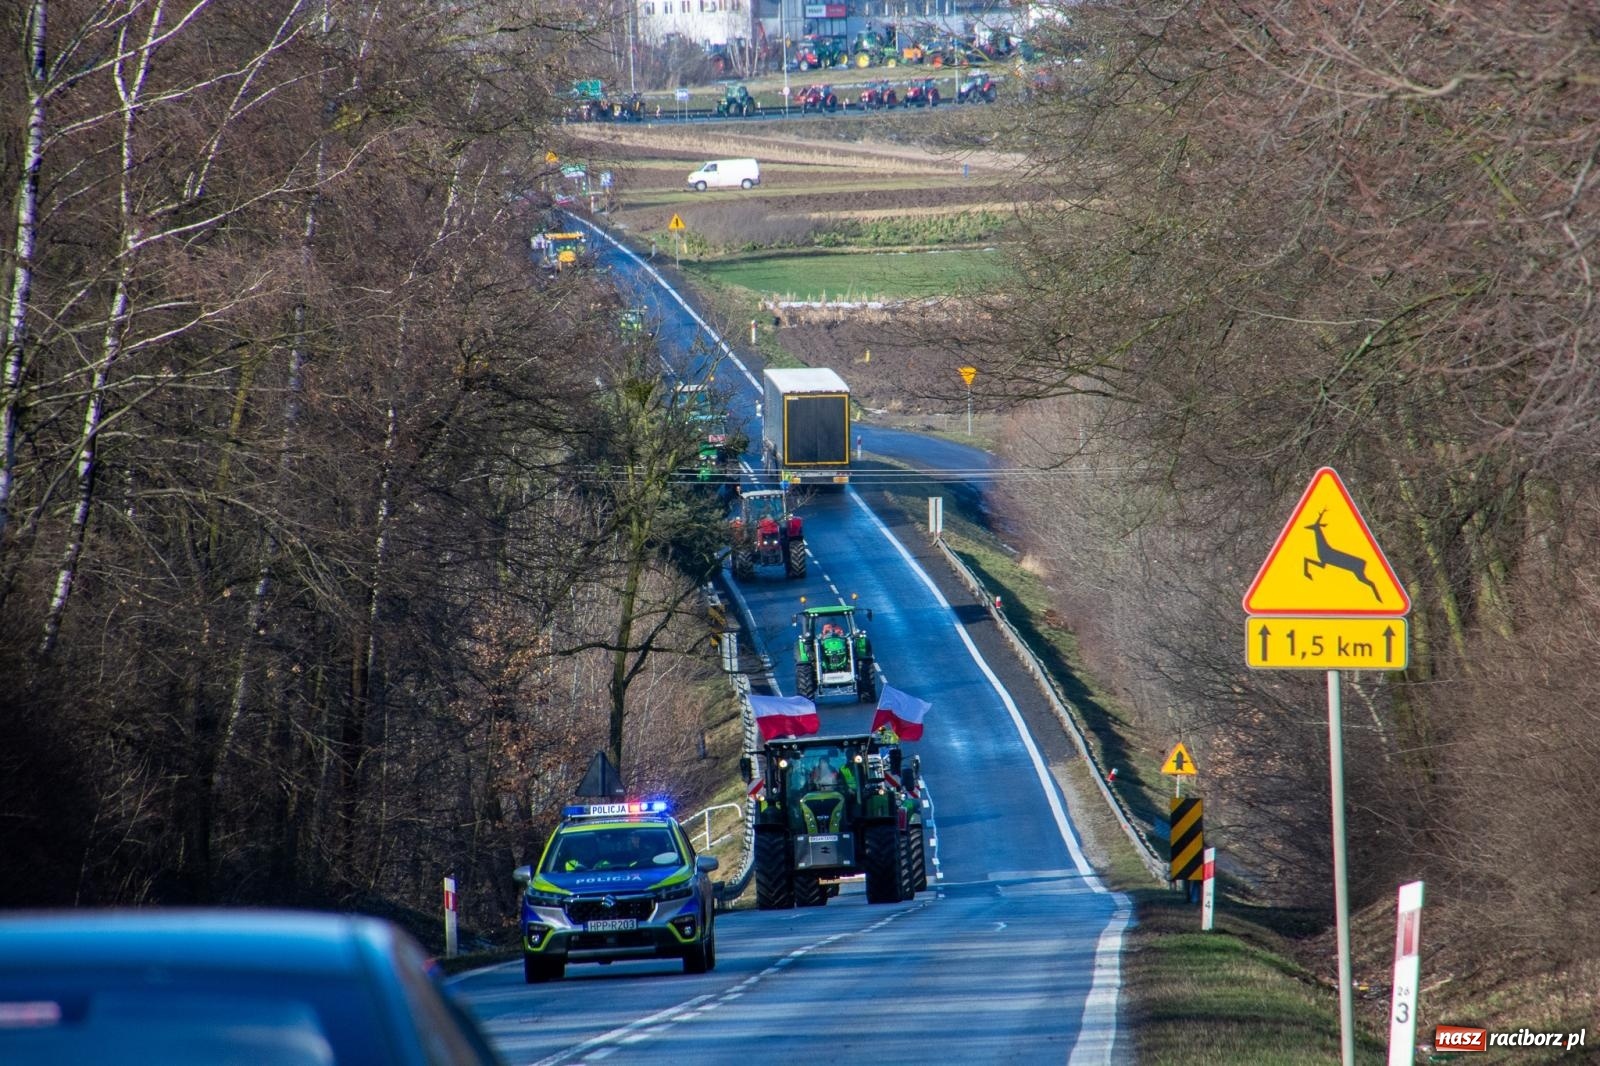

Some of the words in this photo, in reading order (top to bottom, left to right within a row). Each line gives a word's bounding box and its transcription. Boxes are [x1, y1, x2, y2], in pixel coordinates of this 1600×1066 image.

[1286, 629, 1324, 660] 1,5
[1338, 636, 1373, 657] km
[592, 805, 627, 815] POLICJA
[575, 875, 642, 885] POLICJA
[1395, 1002, 1409, 1024] 3
